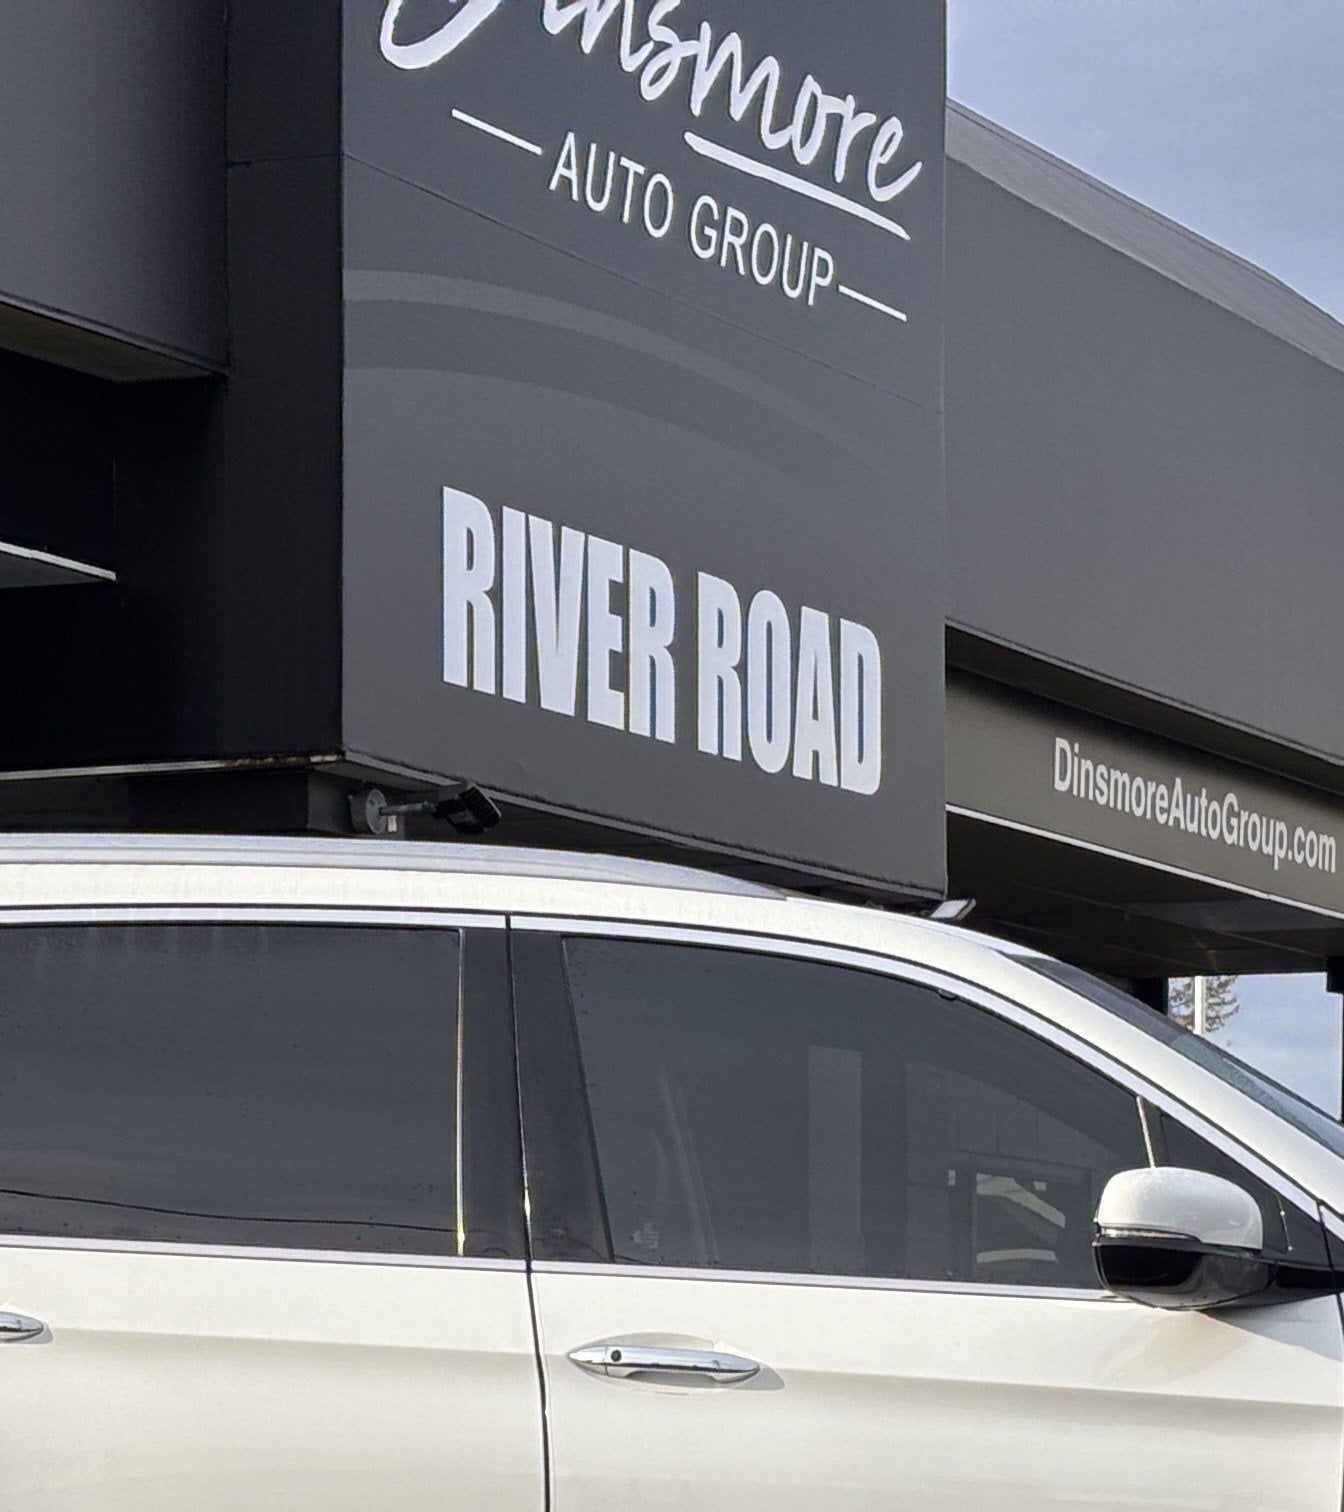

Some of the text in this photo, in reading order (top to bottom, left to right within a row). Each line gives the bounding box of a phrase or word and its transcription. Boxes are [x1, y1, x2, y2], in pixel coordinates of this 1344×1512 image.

[379, 0, 923, 202] nsmore
[549, 131, 835, 306] AUTO GROUP
[442, 485, 882, 796] RIVER ROAD
[1053, 736, 1337, 874] DinsmoreAutoGroup.com
